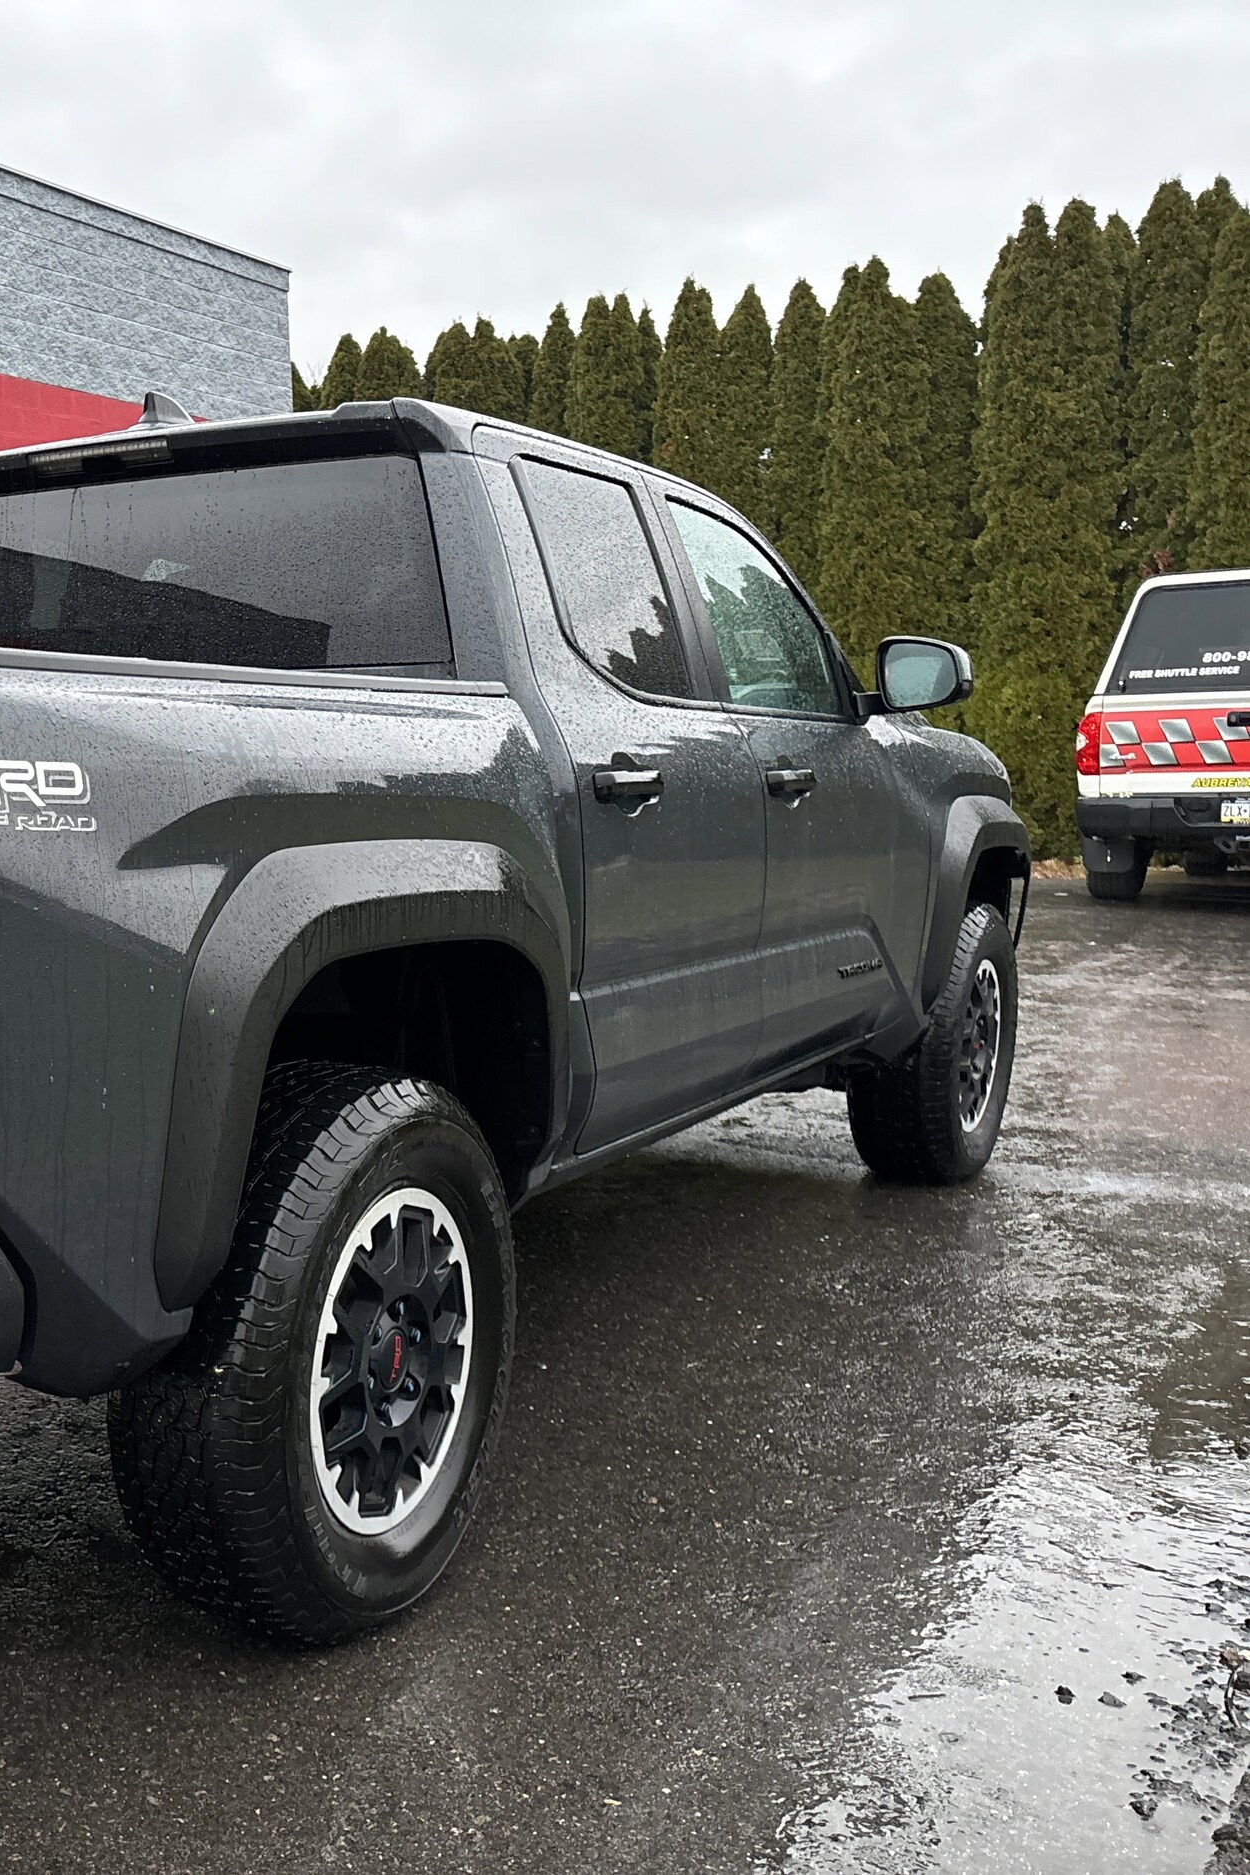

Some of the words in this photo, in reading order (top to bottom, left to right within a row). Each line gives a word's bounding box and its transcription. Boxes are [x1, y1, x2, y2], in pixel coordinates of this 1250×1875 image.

[1129, 670, 1154, 679] FREE
[1154, 667, 1198, 678] SHUTTLE
[1199, 665, 1240, 676] SERVICE
[15, 812, 97, 832] ROAD
[389, 1335, 403, 1383] TRD
